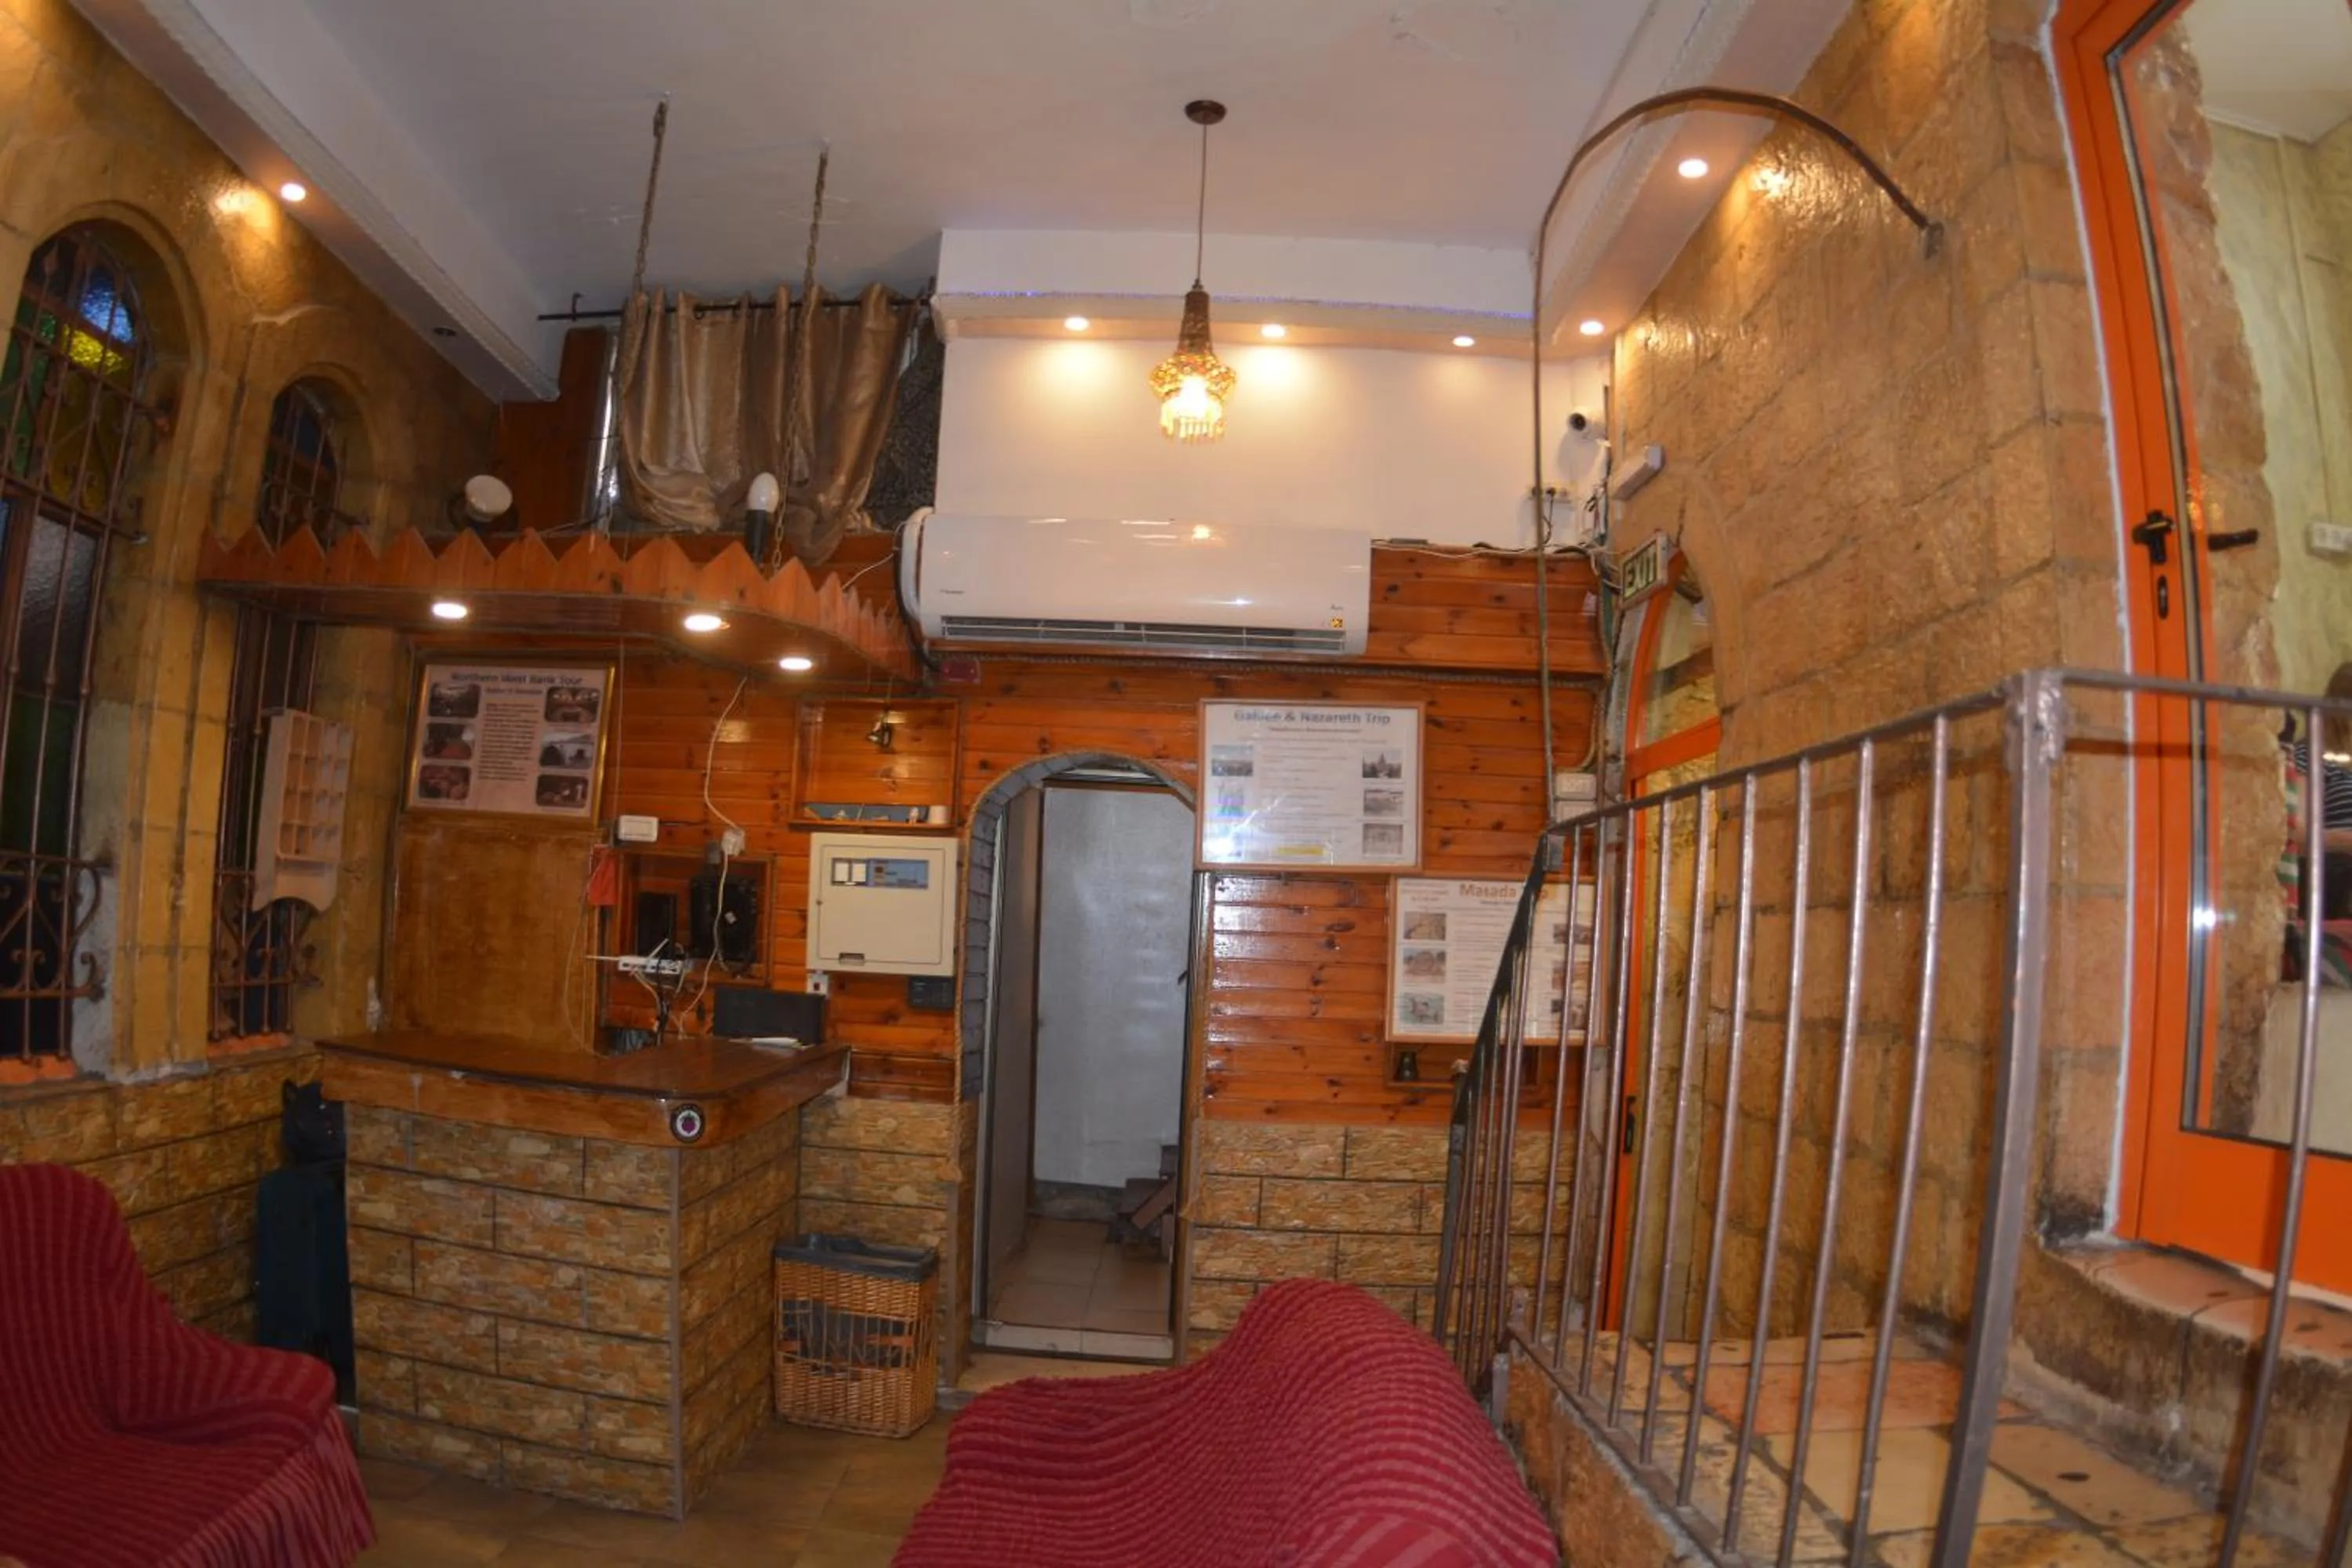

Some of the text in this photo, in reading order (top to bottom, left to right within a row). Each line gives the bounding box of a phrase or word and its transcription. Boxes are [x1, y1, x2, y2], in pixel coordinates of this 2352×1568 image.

[1625, 545, 1657, 598] EXIT
[1283, 710, 1296, 722] &
[1300, 710, 1362, 724] Nazareth
[1364, 712, 1392, 726] Trip
[1459, 883, 1516, 898] Masada
